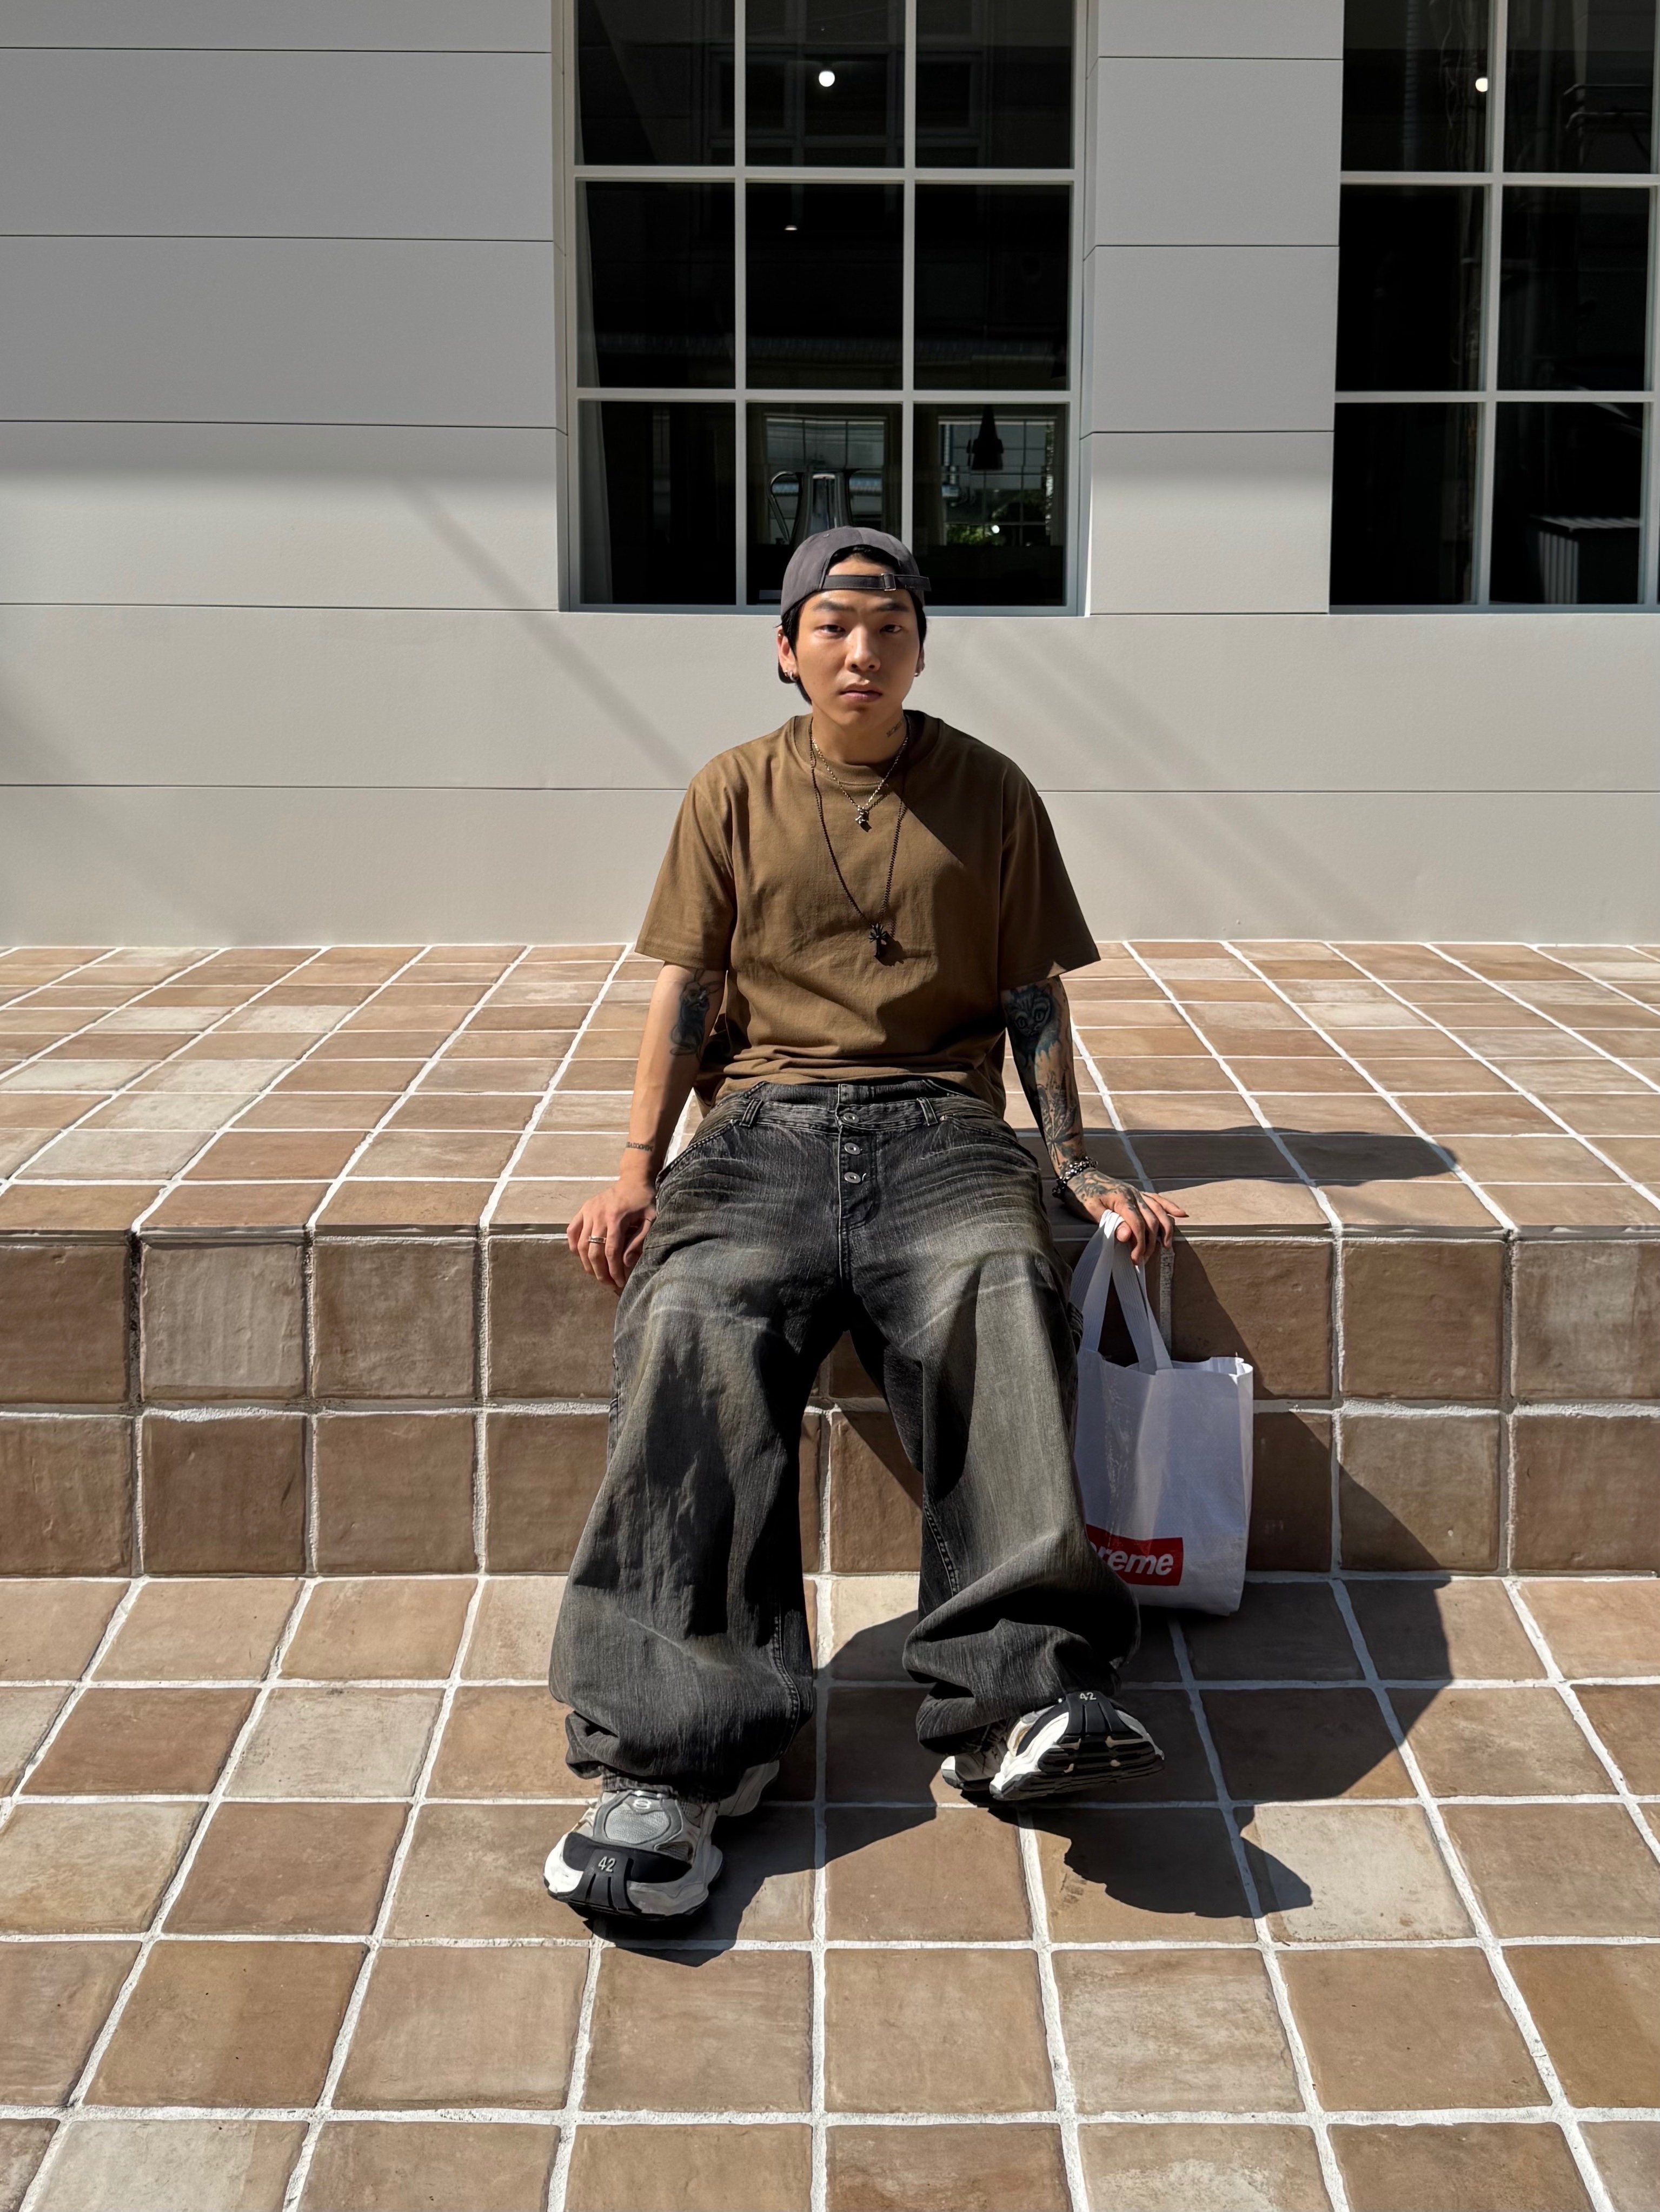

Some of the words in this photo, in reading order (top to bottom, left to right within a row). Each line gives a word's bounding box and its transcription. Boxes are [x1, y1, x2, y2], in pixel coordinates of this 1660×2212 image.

[1090, 1541, 1174, 1576] reme
[1080, 1692, 1097, 1701] 42
[597, 1856, 616, 1873] 42
